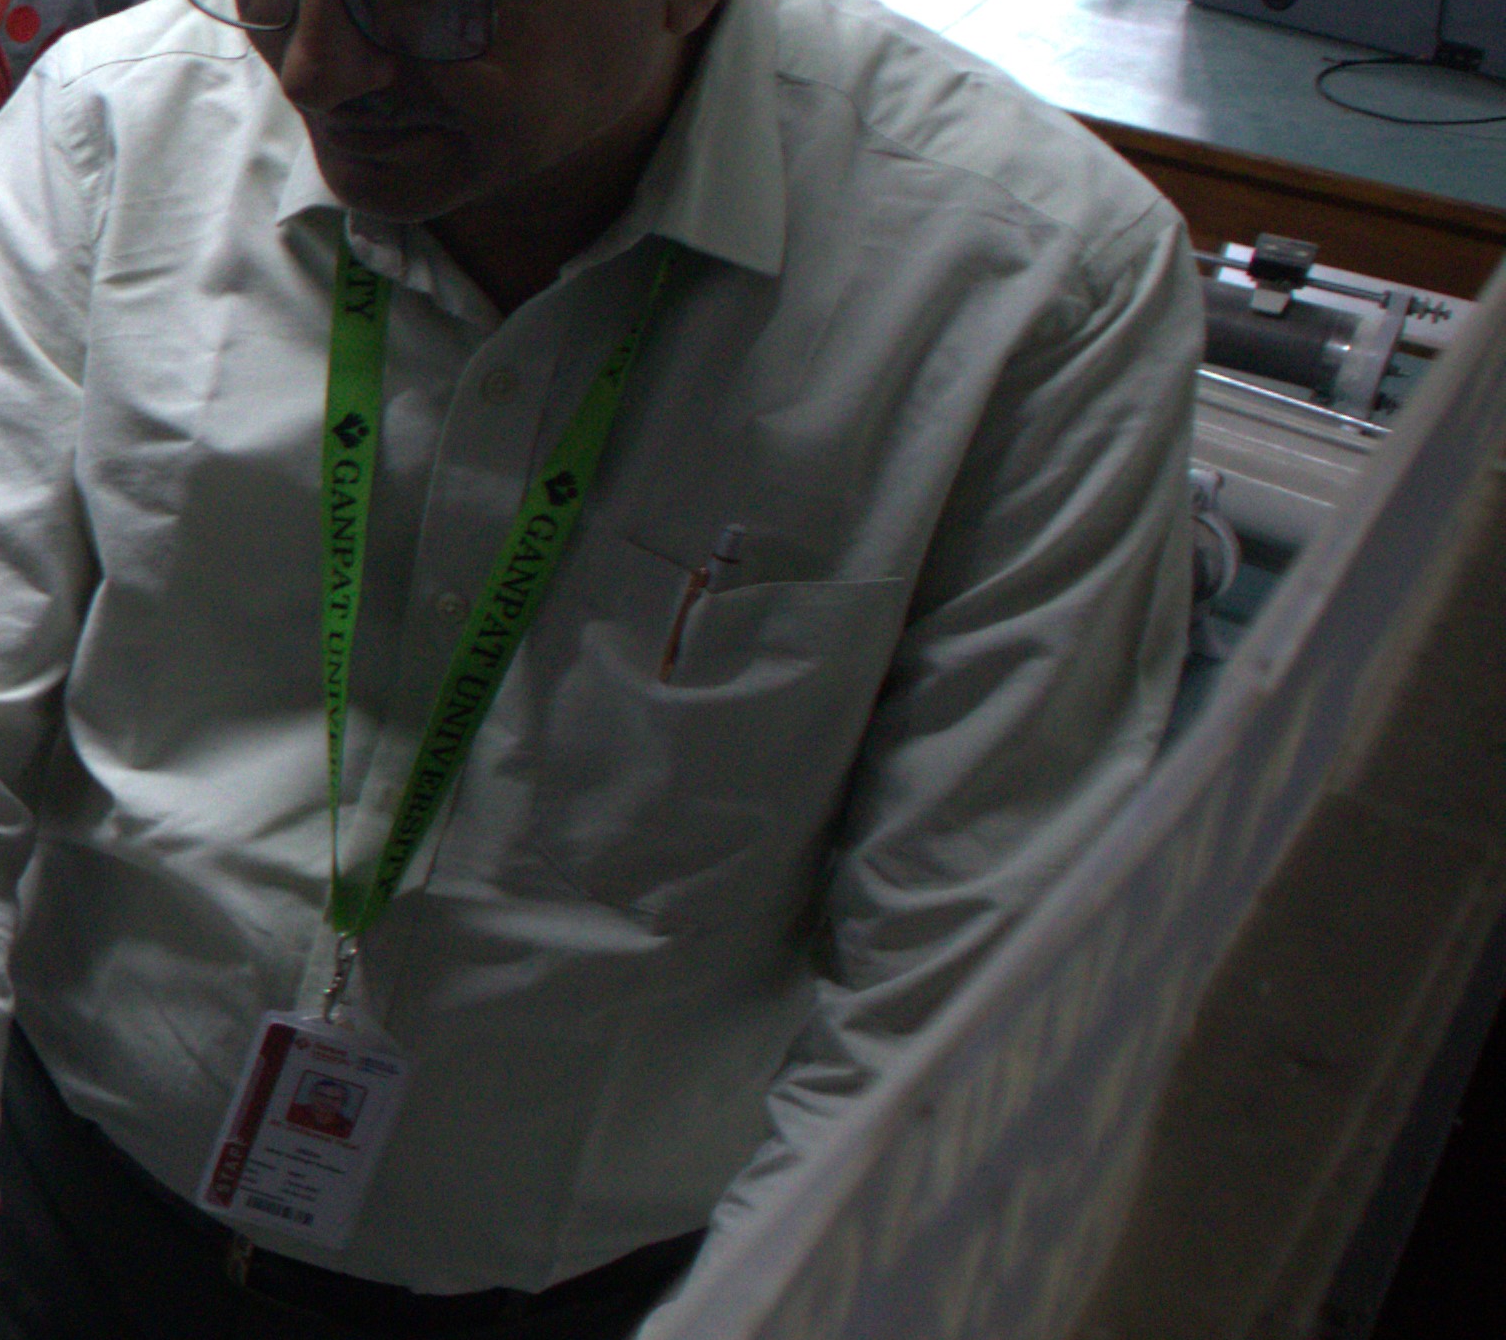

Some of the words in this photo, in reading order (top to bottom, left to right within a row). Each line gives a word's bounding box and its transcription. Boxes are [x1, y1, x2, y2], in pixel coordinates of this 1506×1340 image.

[328, 459, 362, 624] GANPAT
[471, 513, 558, 671] GANPAT
[378, 669, 485, 898] UNIVERSITY
